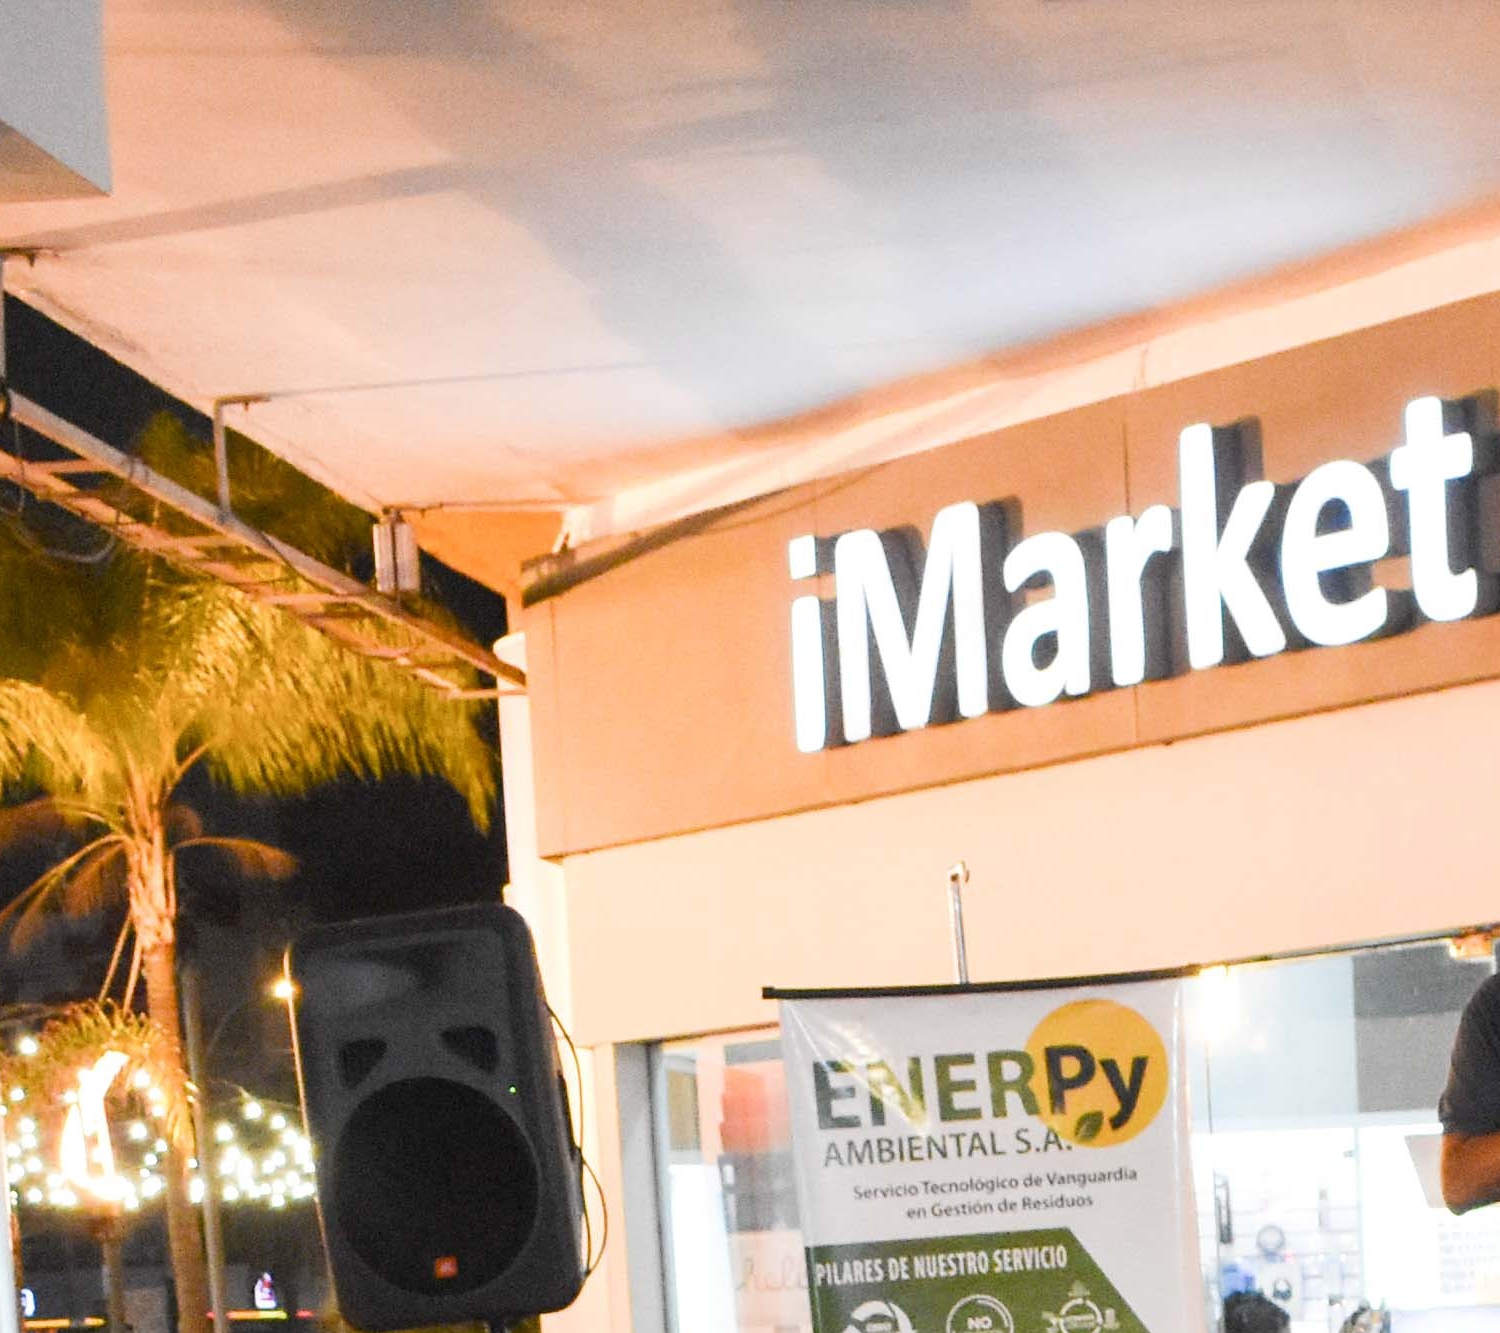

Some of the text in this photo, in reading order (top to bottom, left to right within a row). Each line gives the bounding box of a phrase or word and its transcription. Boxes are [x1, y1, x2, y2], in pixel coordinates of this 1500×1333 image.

[788, 395, 1479, 753] iMarket
[813, 1043, 1150, 1131] ENERPy
[823, 1127, 1073, 1168] AMBIENTAL S.A.
[854, 1165, 1138, 1200] Servicio Tecnológico de Vanguardia
[906, 1193, 1093, 1221] en Gestión de Residuos
[816, 1245, 1068, 1286] PILARES DE NUESTRO SERVICIO
[966, 1316, 993, 1330] NO
